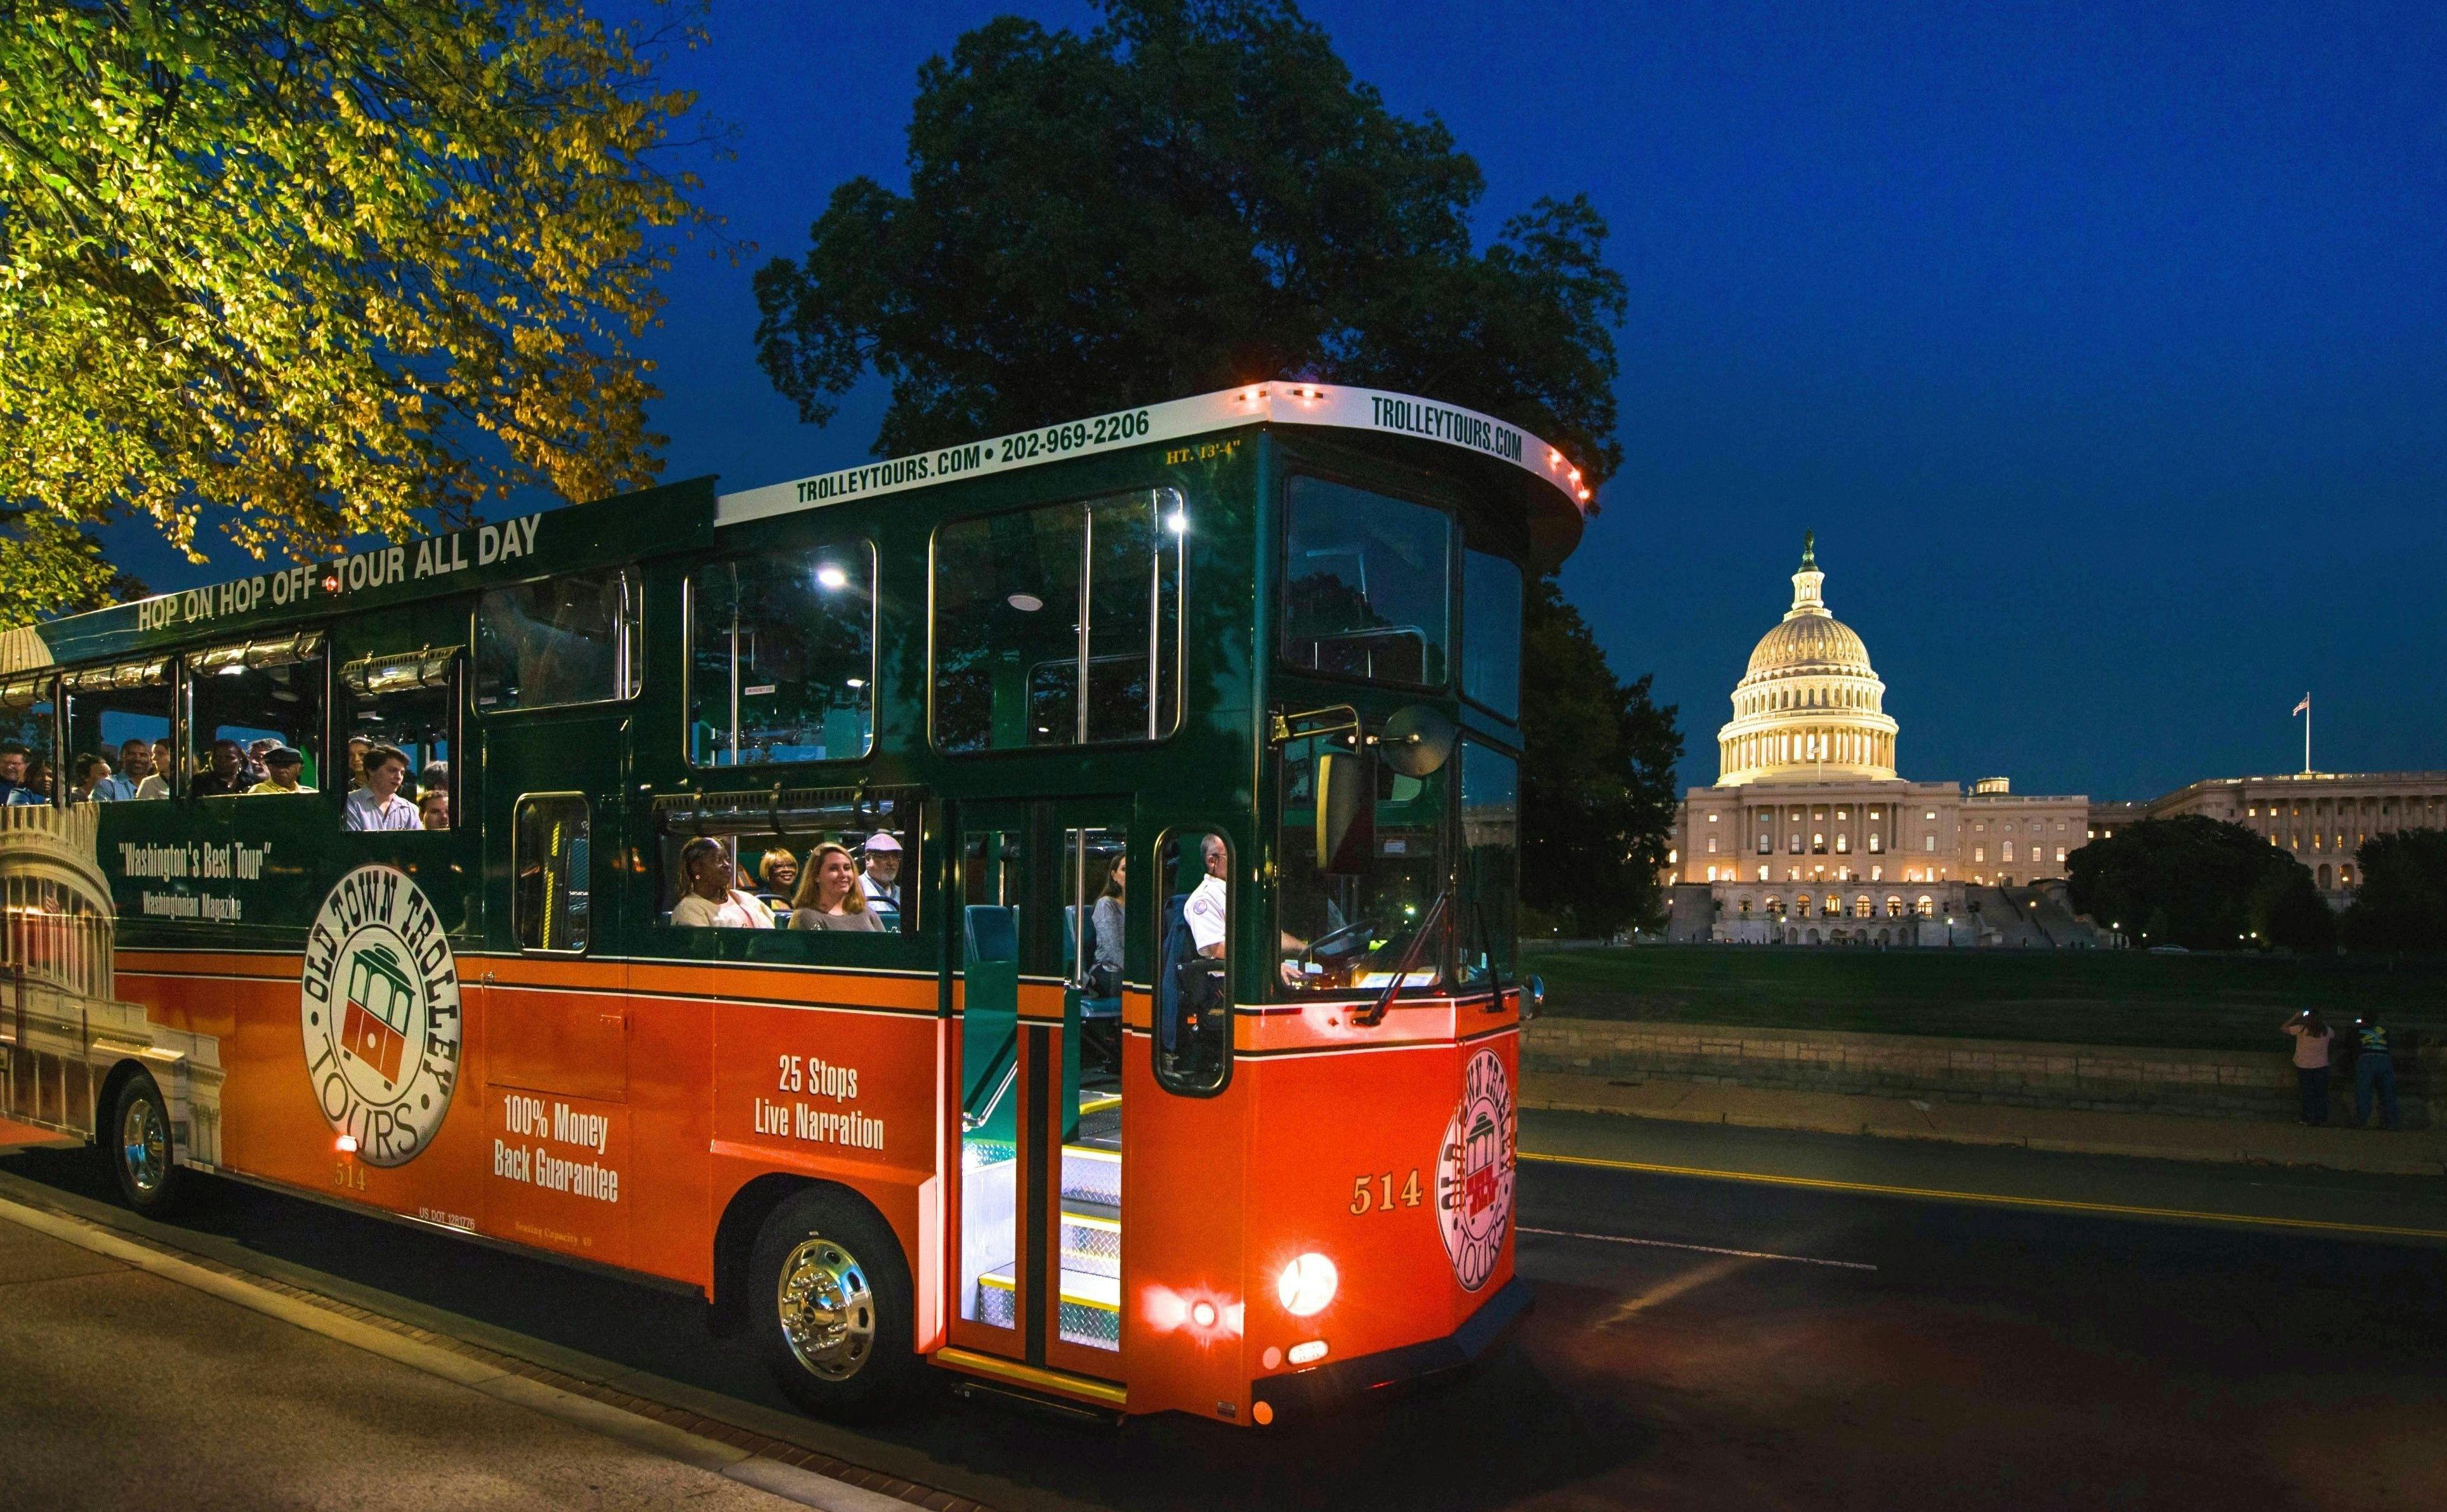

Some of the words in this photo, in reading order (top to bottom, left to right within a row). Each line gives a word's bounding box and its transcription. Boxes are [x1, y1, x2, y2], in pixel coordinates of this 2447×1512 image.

[797, 445, 980, 503] TROLLEYTOURS.COM
[1001, 410, 1149, 463] 202-969-2206
[1166, 448, 1194, 465] HT.
[1371, 397, 1522, 462] TROLLEYTOURS.COM
[138, 595, 178, 632] HOP
[185, 586, 213, 623] ON
[220, 576, 266, 615] HOP
[273, 564, 316, 605] OFF
[333, 546, 405, 593] TOUR
[414, 533, 468, 579] ALL
[479, 513, 542, 566] DAY
[204, 842, 230, 879] Best
[143, 891, 199, 919] Washingtonian
[202, 893, 242, 922] Magazine
[305, 923, 338, 1003] OLD
[329, 870, 398, 937] TOWN
[400, 886, 458, 1096] TROLLEY
[311, 1032, 418, 1160] TOURS
[779, 1055, 801, 1092] 25
[809, 1057, 857, 1103] Stops
[504, 1095, 548, 1138] 100%
[554, 1103, 608, 1155] Money
[755, 1098, 789, 1136] Live
[796, 1103, 883, 1150] Narration
[334, 1162, 366, 1192] 514
[494, 1139, 531, 1183] Back
[536, 1148, 618, 1203] Guarantee
[1350, 1167, 1423, 1216] 514
[419, 1206, 429, 1219] US
[432, 1209, 445, 1222] DOT
[1457, 1204, 1505, 1284] TOURS
